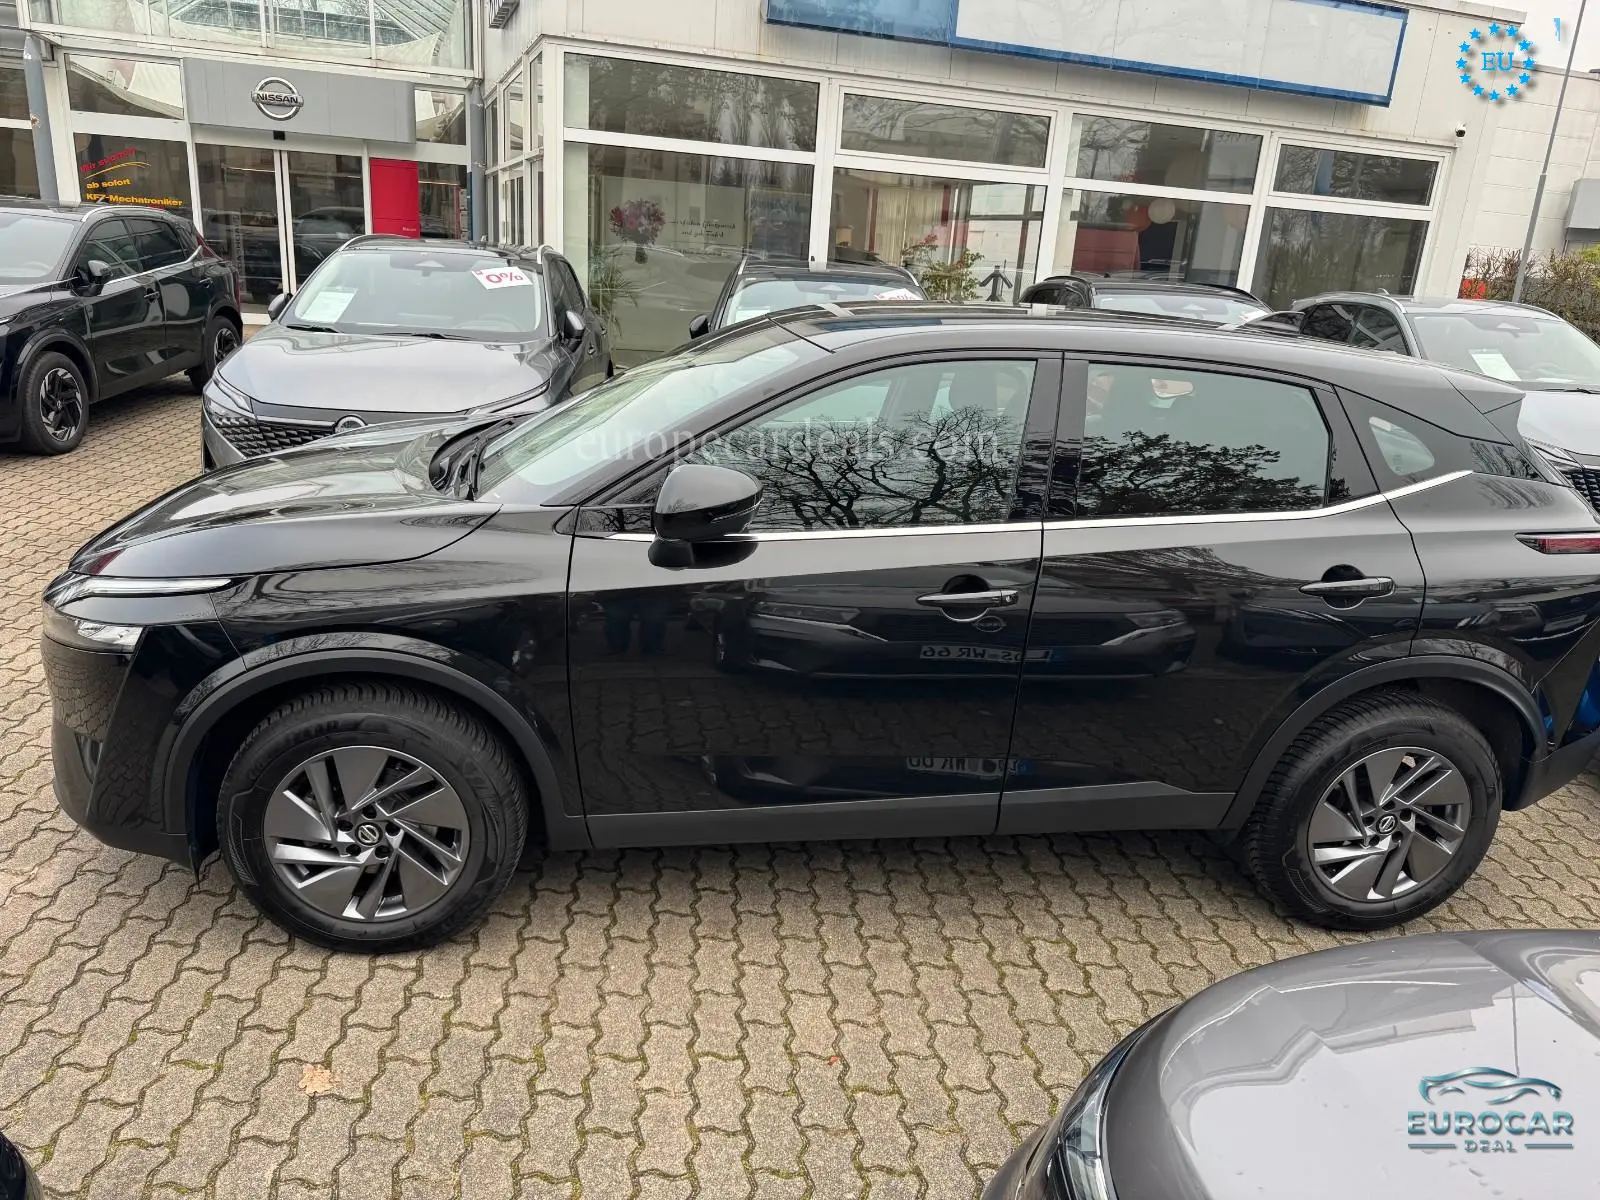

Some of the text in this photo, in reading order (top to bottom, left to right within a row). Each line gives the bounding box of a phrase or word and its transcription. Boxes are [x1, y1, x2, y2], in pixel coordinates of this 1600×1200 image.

[256, 93, 298, 103] NISSAN
[101, 178, 131, 188] sofort
[486, 272, 524, 284] 0%
